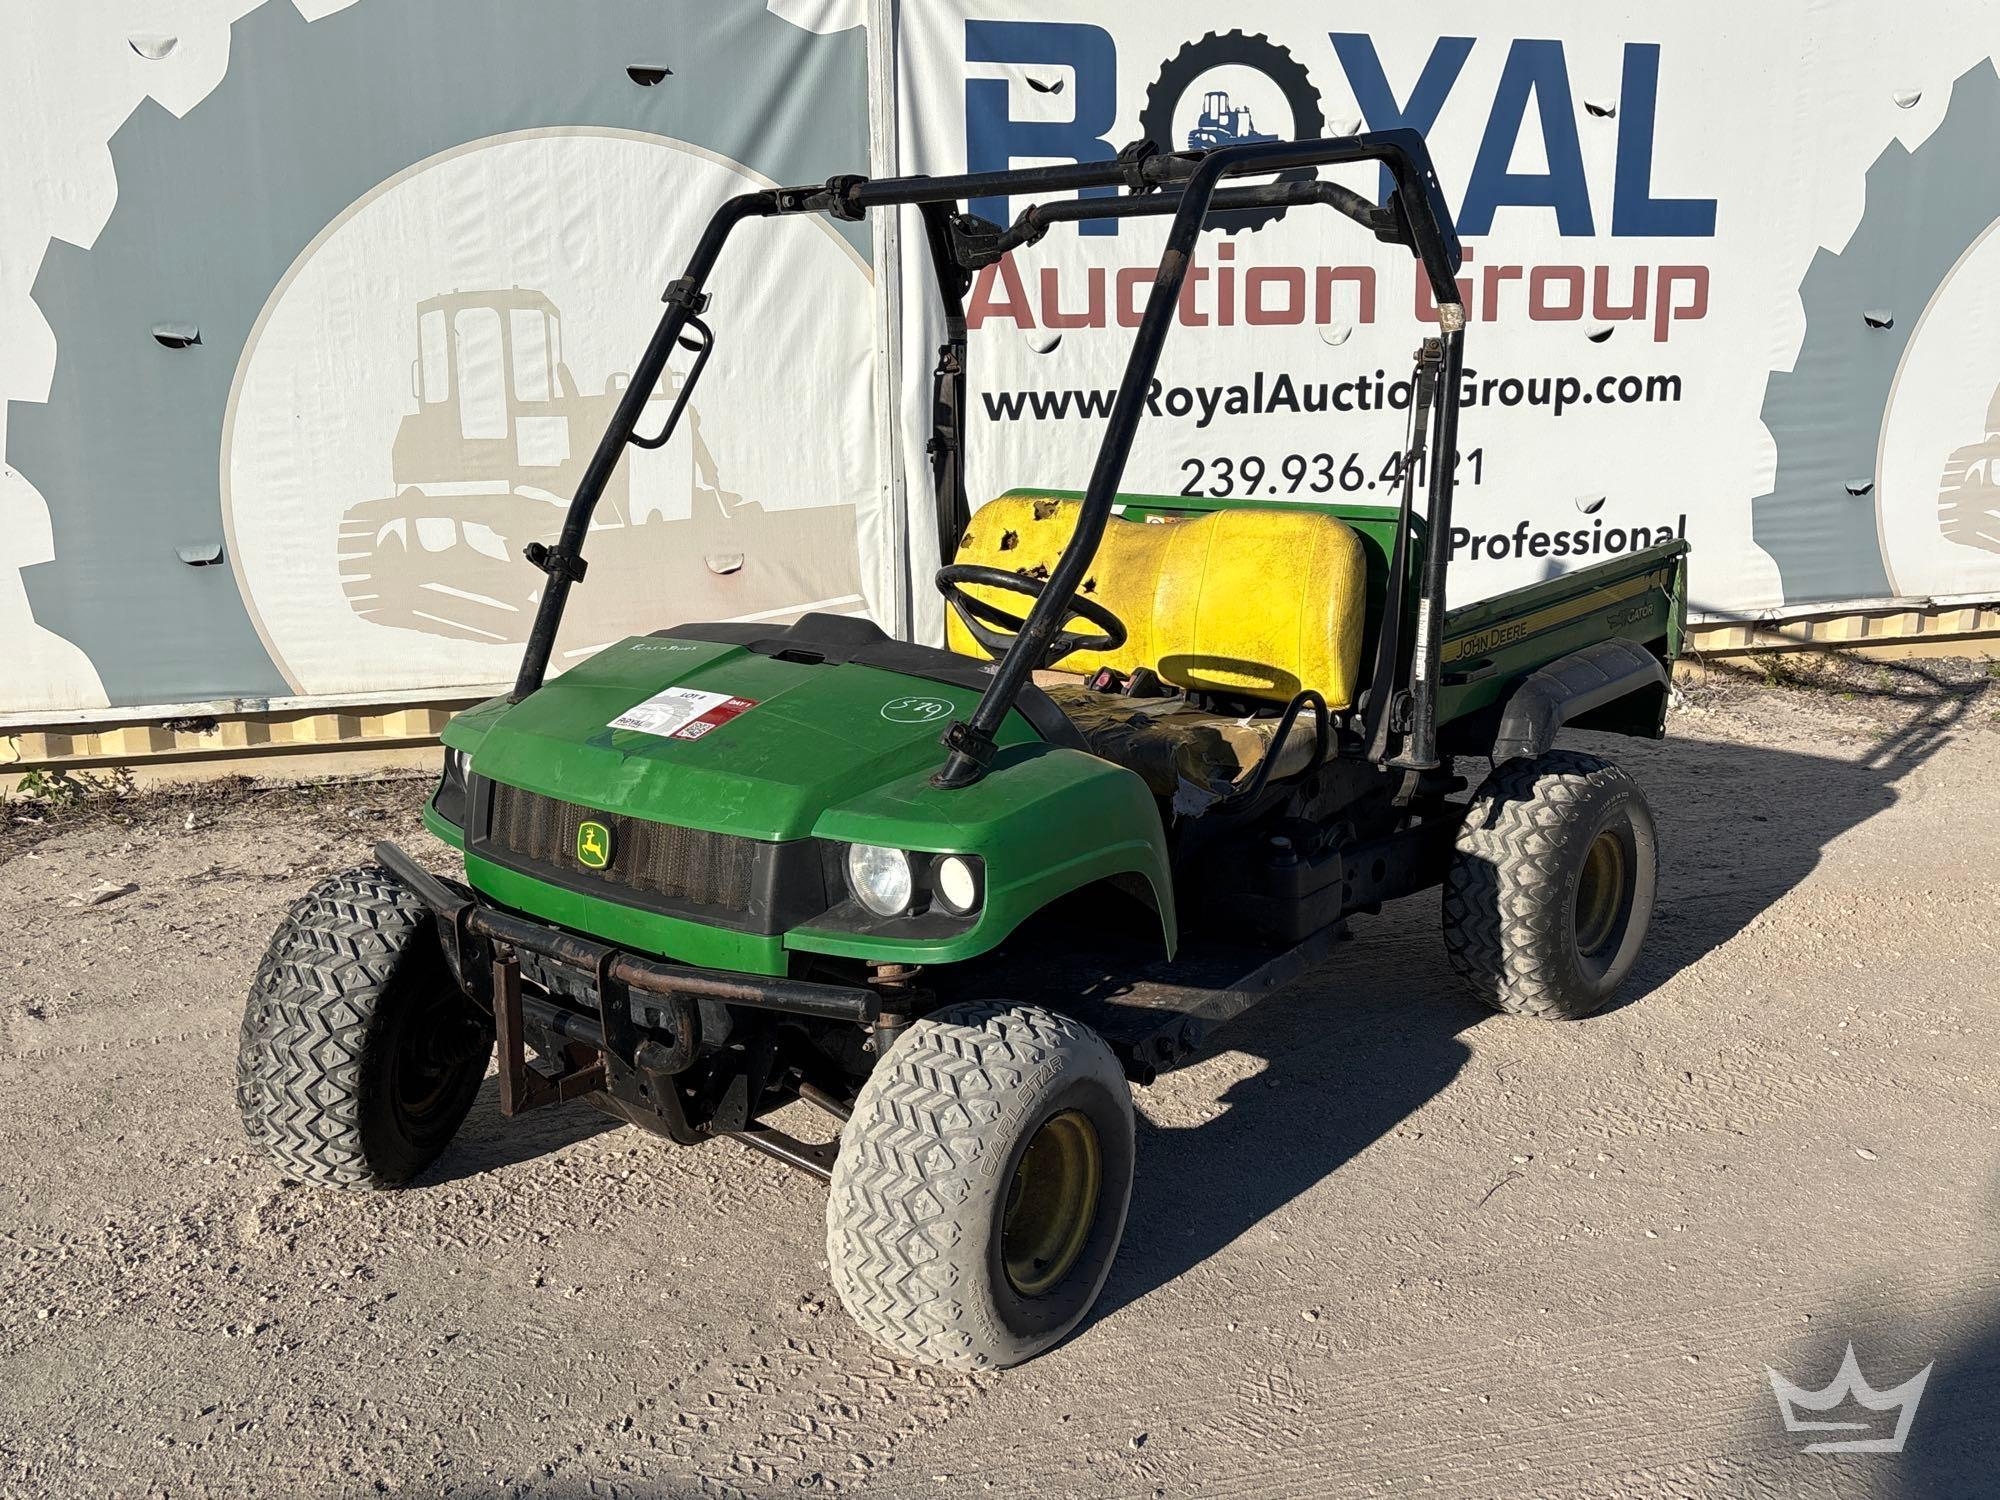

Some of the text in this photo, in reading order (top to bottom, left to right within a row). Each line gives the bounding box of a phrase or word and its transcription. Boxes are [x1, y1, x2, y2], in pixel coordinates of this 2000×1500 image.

[967, 243, 1375, 330] Auction
[1627, 602, 1655, 624] GATOR
[1455, 621, 1528, 660] JOHN DEERE
[680, 692, 700, 700] LOT
[979, 1054, 1064, 1178] CARLSTAR
